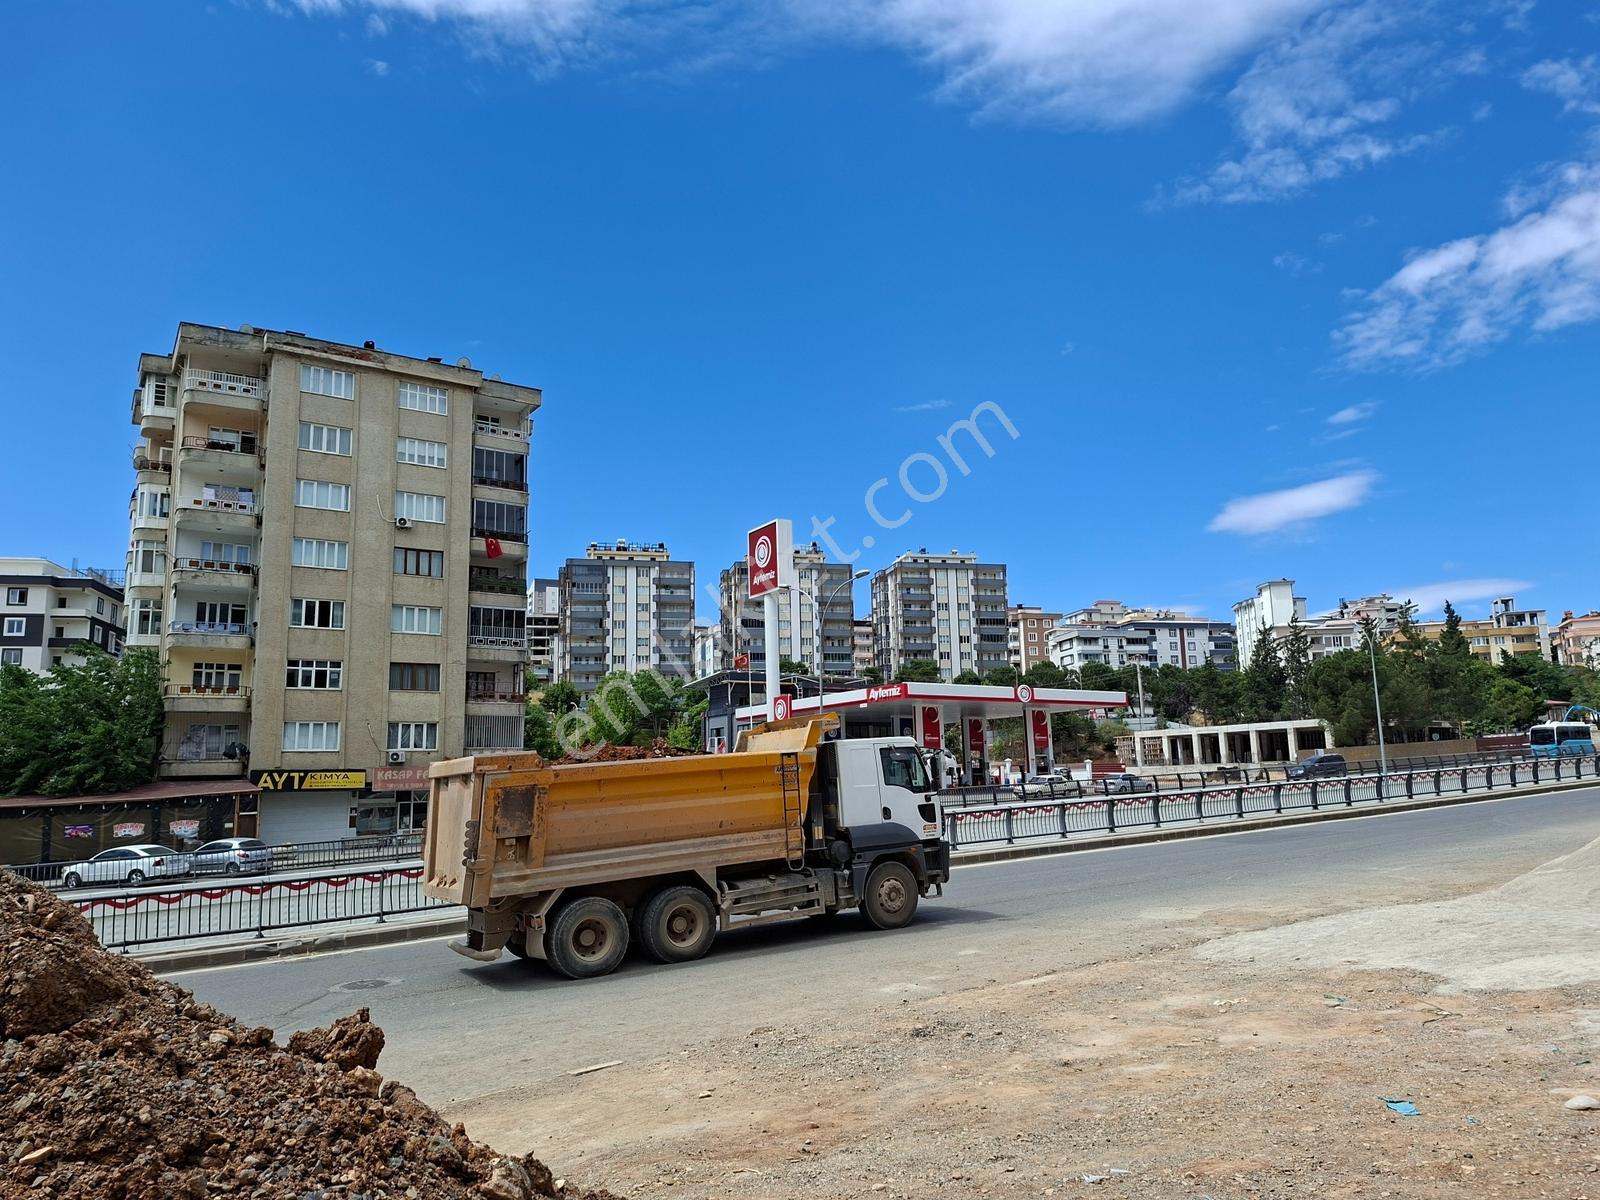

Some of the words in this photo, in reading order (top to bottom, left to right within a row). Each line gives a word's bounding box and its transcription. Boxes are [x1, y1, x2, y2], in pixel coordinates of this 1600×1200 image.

[753, 569, 776, 586] Aytemiz
[868, 685, 902, 702] Aytemiz
[257, 772, 304, 790] AYT
[376, 770, 413, 780] KASAP
